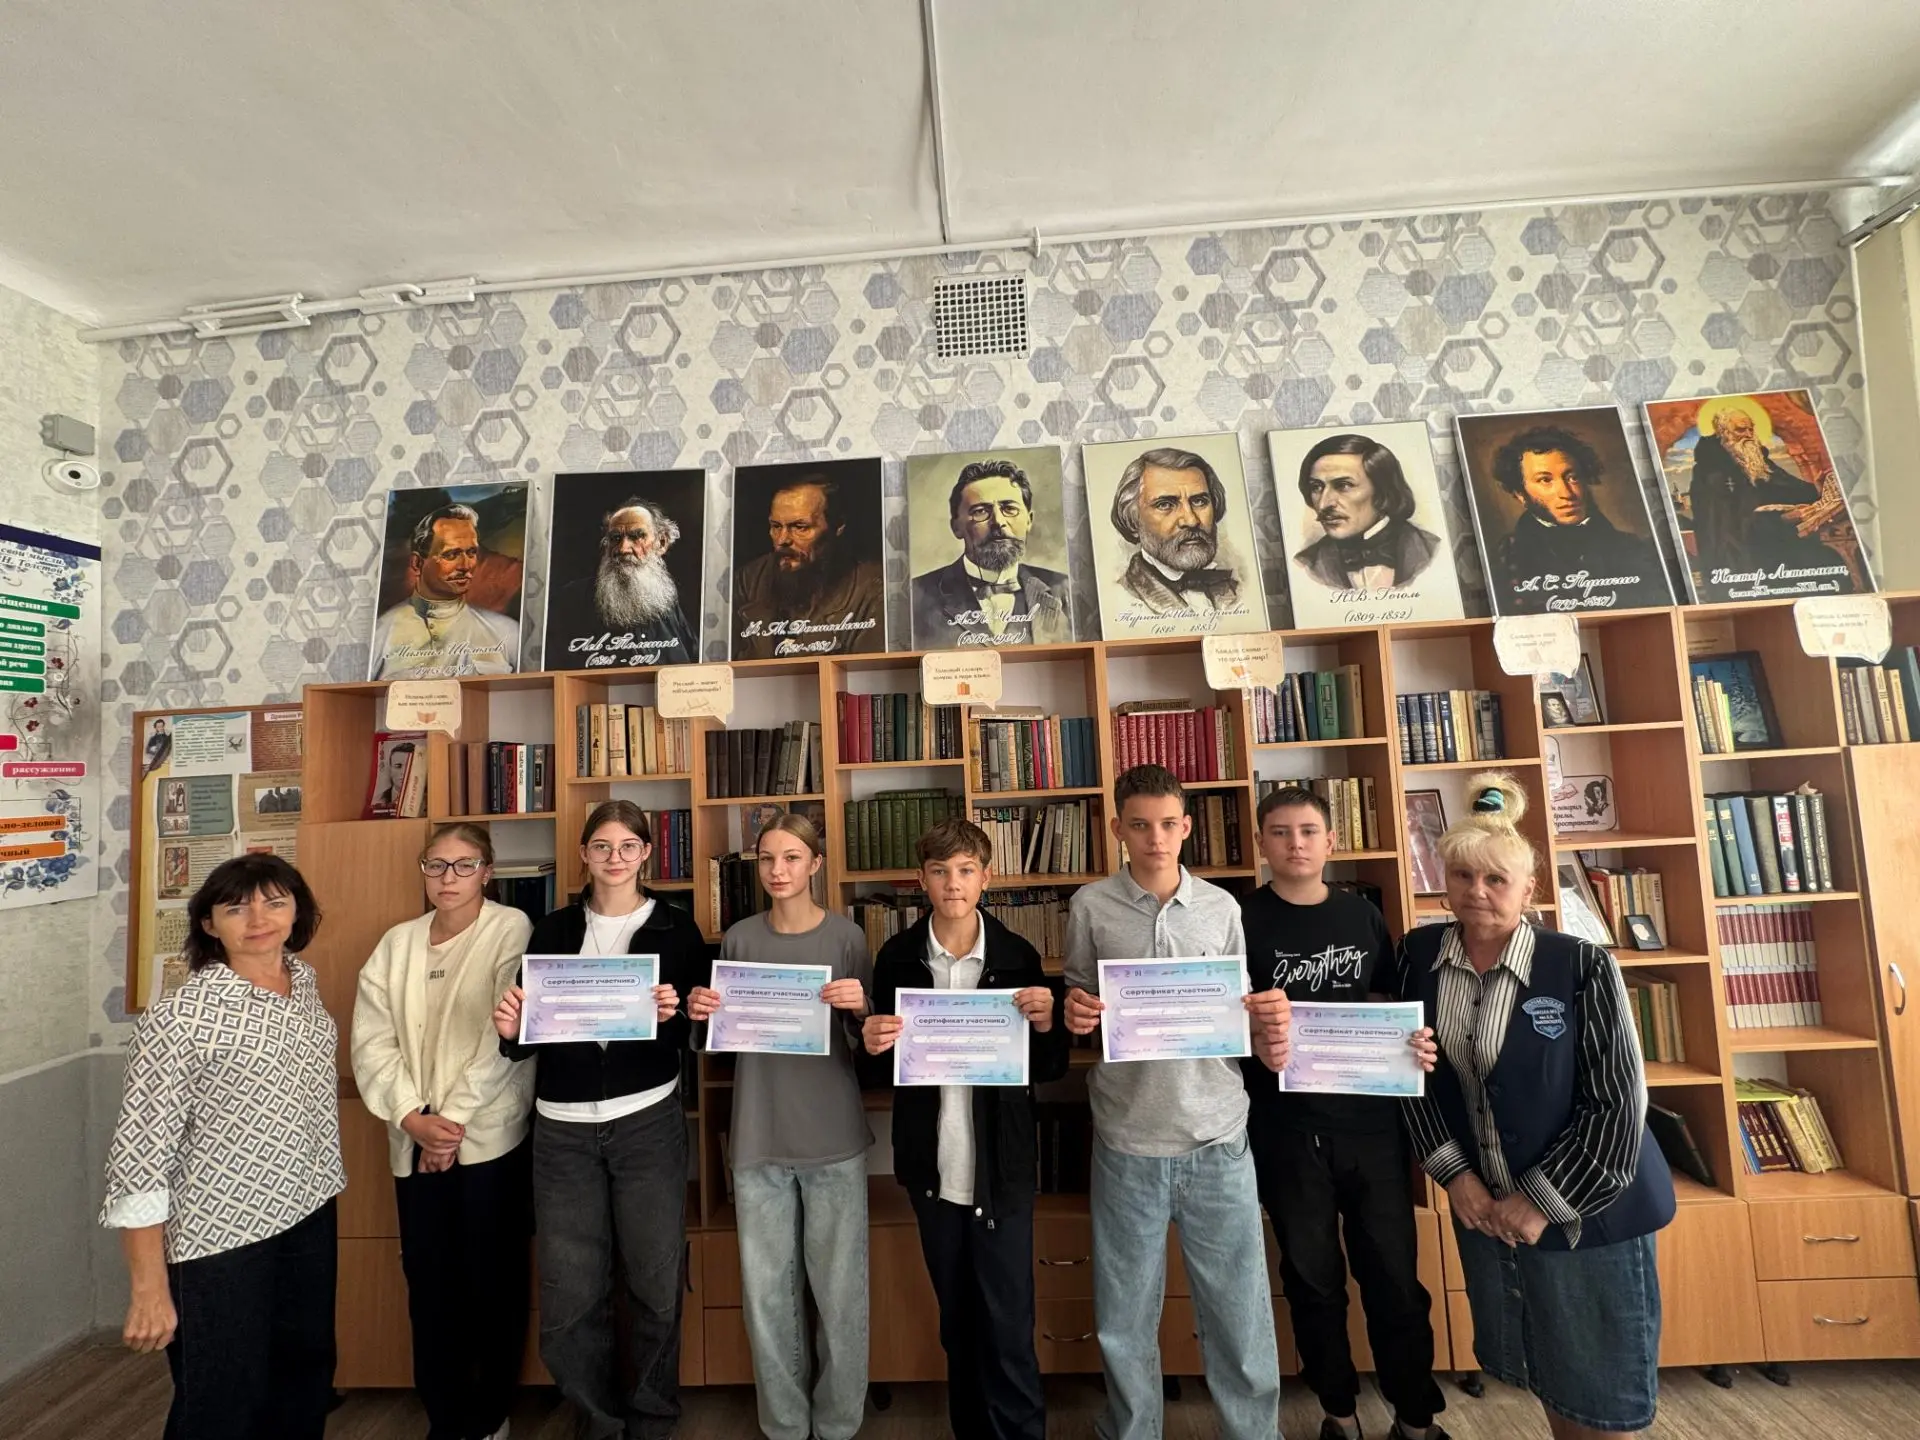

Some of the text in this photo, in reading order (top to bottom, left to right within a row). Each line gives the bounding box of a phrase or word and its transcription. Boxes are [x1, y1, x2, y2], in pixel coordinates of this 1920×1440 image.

[19, 560, 63, 574] Толстой
[1711, 563, 1849, 587] Нестор Летописец
[1514, 570, 1640, 597] А. С. Пушкин
[1375, 587, 1420, 601] Гоголь
[1000, 602, 1040, 623] Чехов
[1344, 607, 1413, 624] (1809-1852)
[788, 612, 877, 635] Достоевский
[568, 633, 679, 652] Лев Толстой
[12, 766, 77, 775] рассуждение
[1272, 944, 1368, 992] Everything
[730, 989, 809, 999] сертификат участника
[1125, 986, 1222, 996] сертификат участника
[1303, 1028, 1399, 1037] сертификат участника
